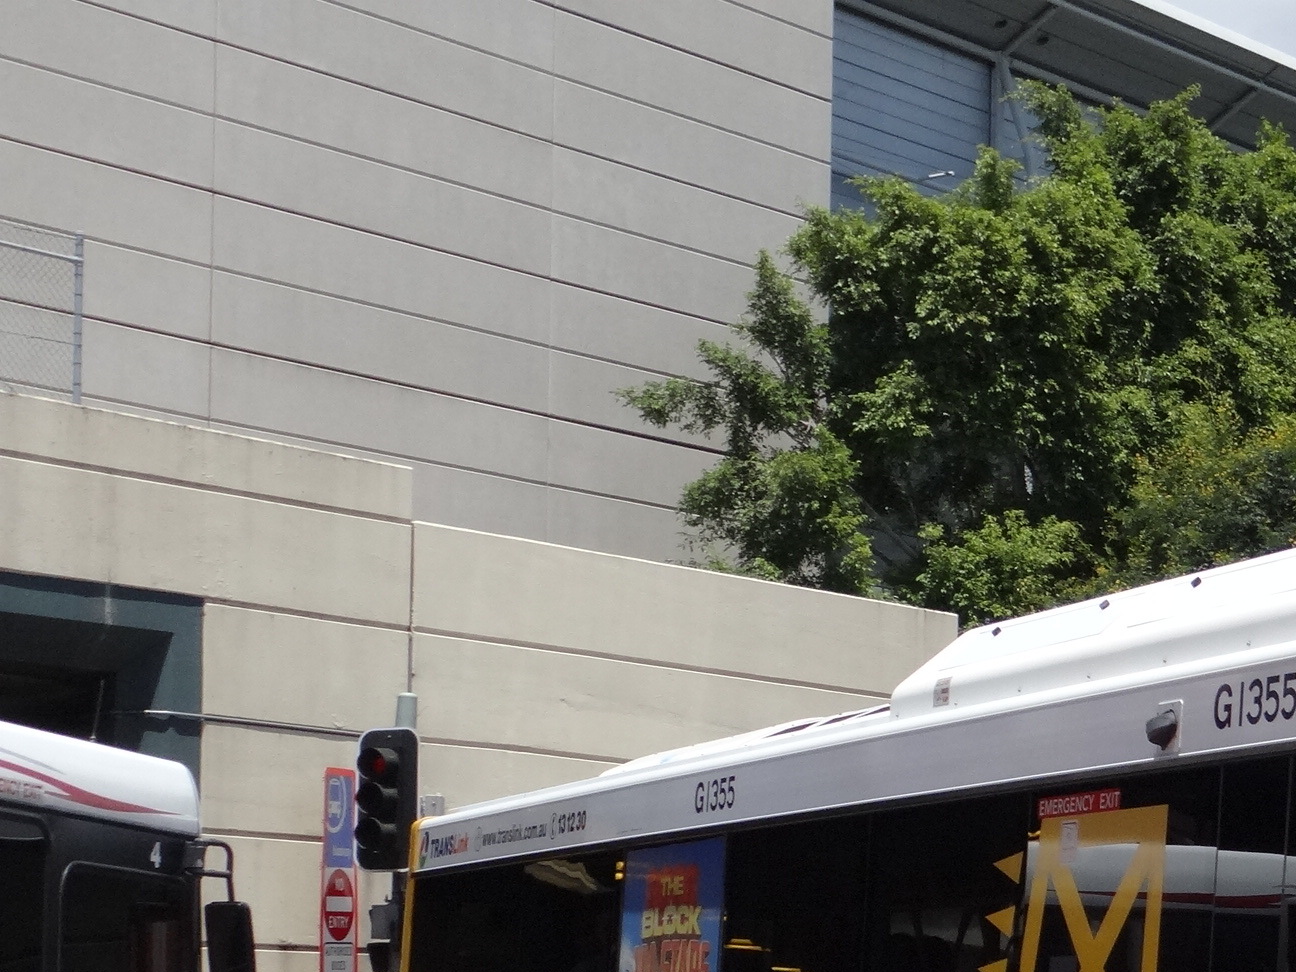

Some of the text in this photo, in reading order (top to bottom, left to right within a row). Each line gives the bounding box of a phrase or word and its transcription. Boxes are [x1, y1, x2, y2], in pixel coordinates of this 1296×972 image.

[695, 776, 735, 813] G1355
[1039, 791, 1121, 816] EMERGENCY EXIT
[150, 841, 162, 869] 4
[430, 831, 470, 858] TRANSLink
[661, 875, 685, 896] THE
[328, 916, 350, 928] ENTRY
[641, 905, 702, 938] BLOCK
